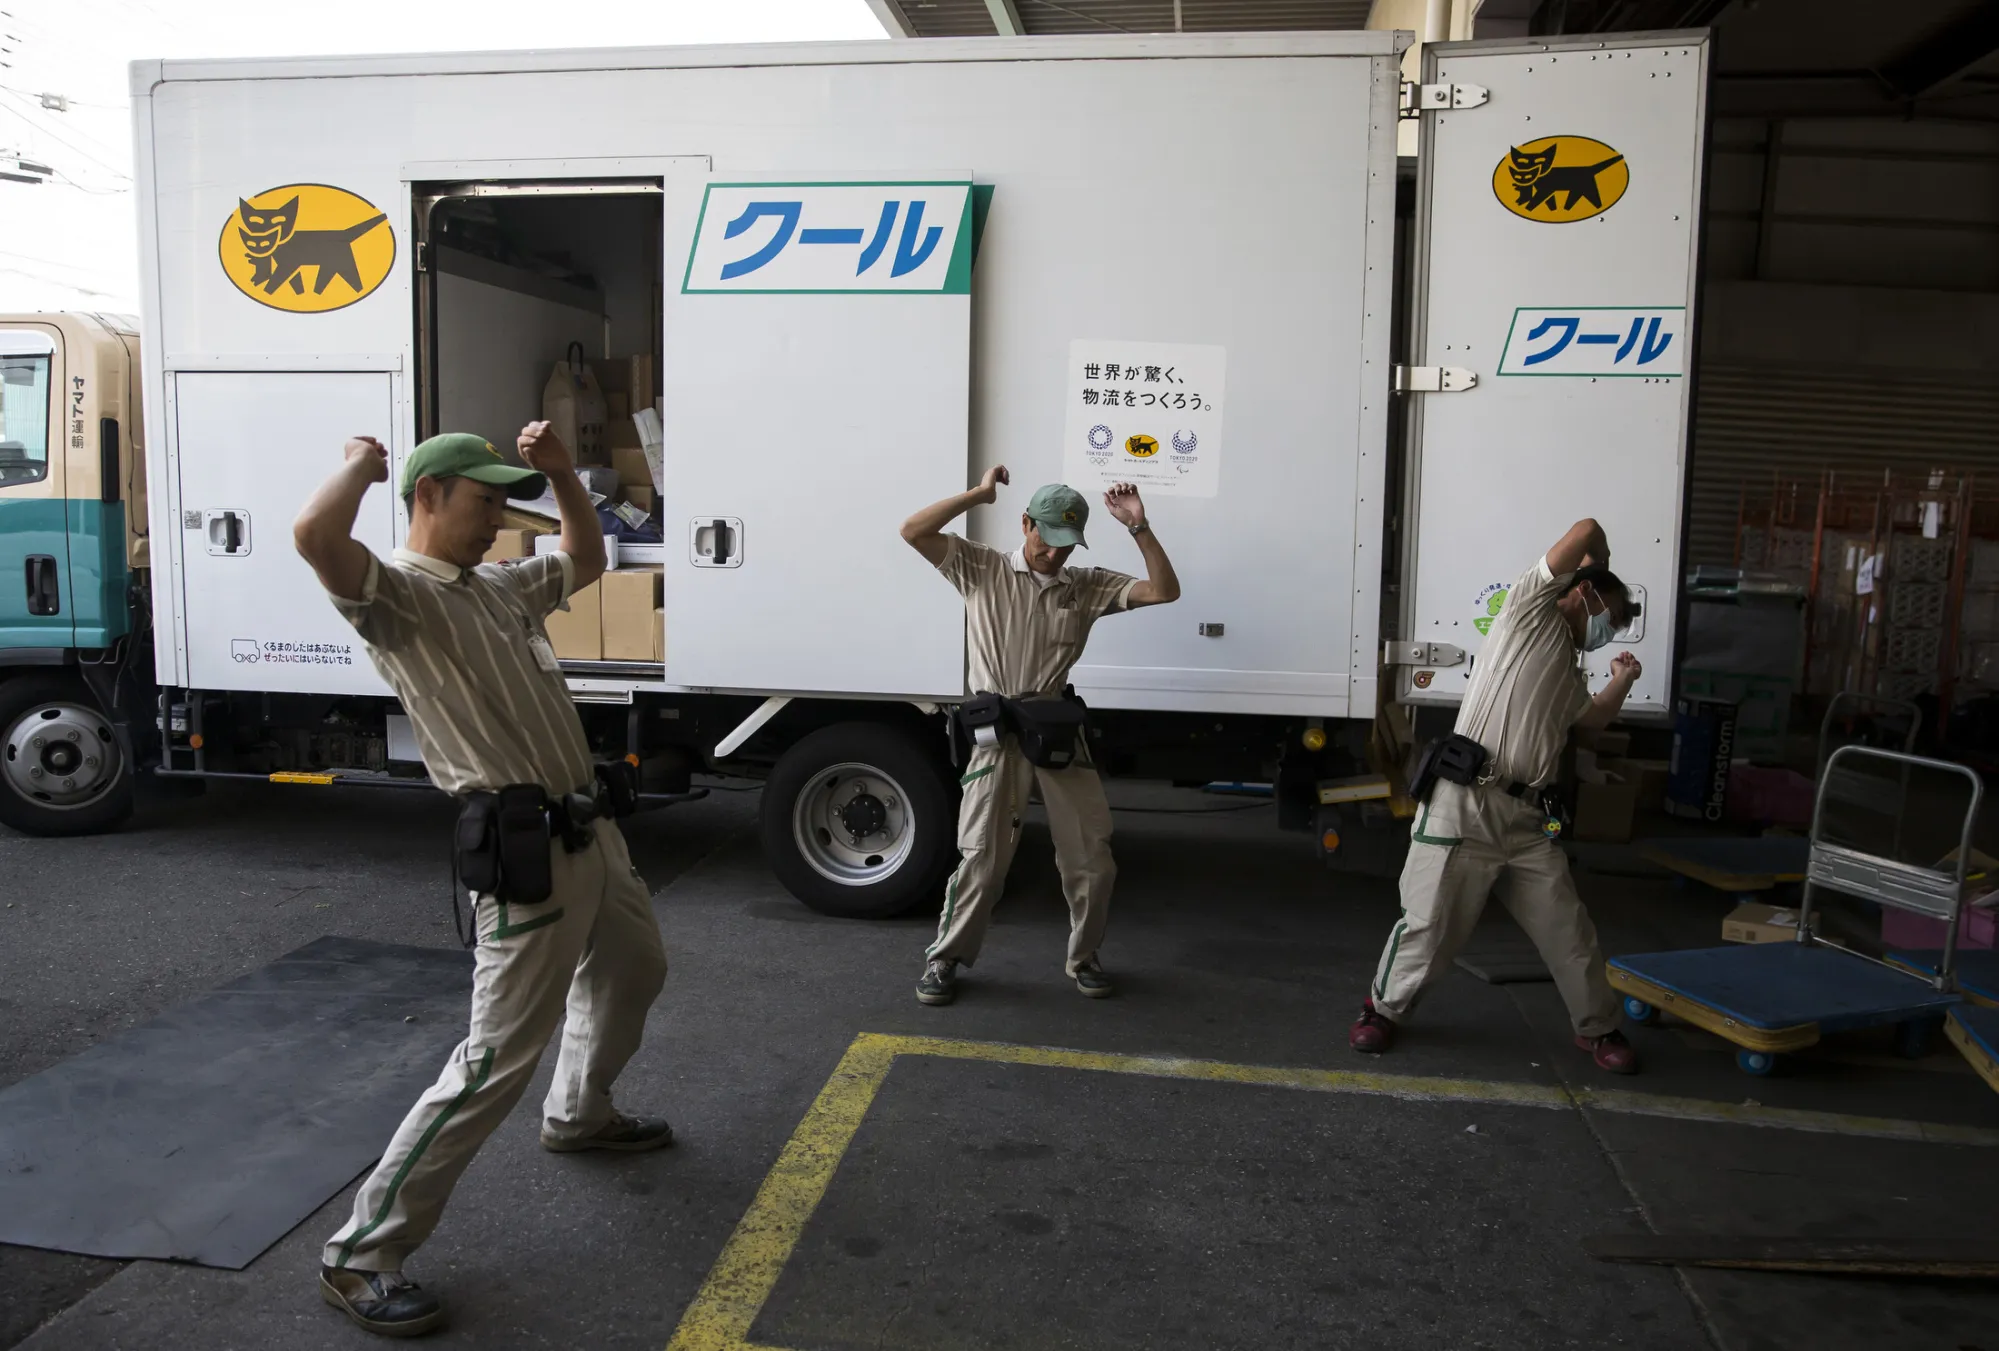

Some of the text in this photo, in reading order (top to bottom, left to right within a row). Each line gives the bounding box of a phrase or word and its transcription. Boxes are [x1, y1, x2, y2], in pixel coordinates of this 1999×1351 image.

[720, 201, 944, 280] クール
[1523, 317, 1673, 366] クール
[1084, 363, 1184, 384] 世界が驚く、
[72, 376, 84, 448] ヤマト運輸
[1083, 389, 1211, 411] 物流をつくろう。
[264, 642, 351, 653] くるまのしたはあぶないよ
[264, 653, 351, 664] ぜったいにはいらないでね
[1705, 720, 1734, 821] Cleanstorm
